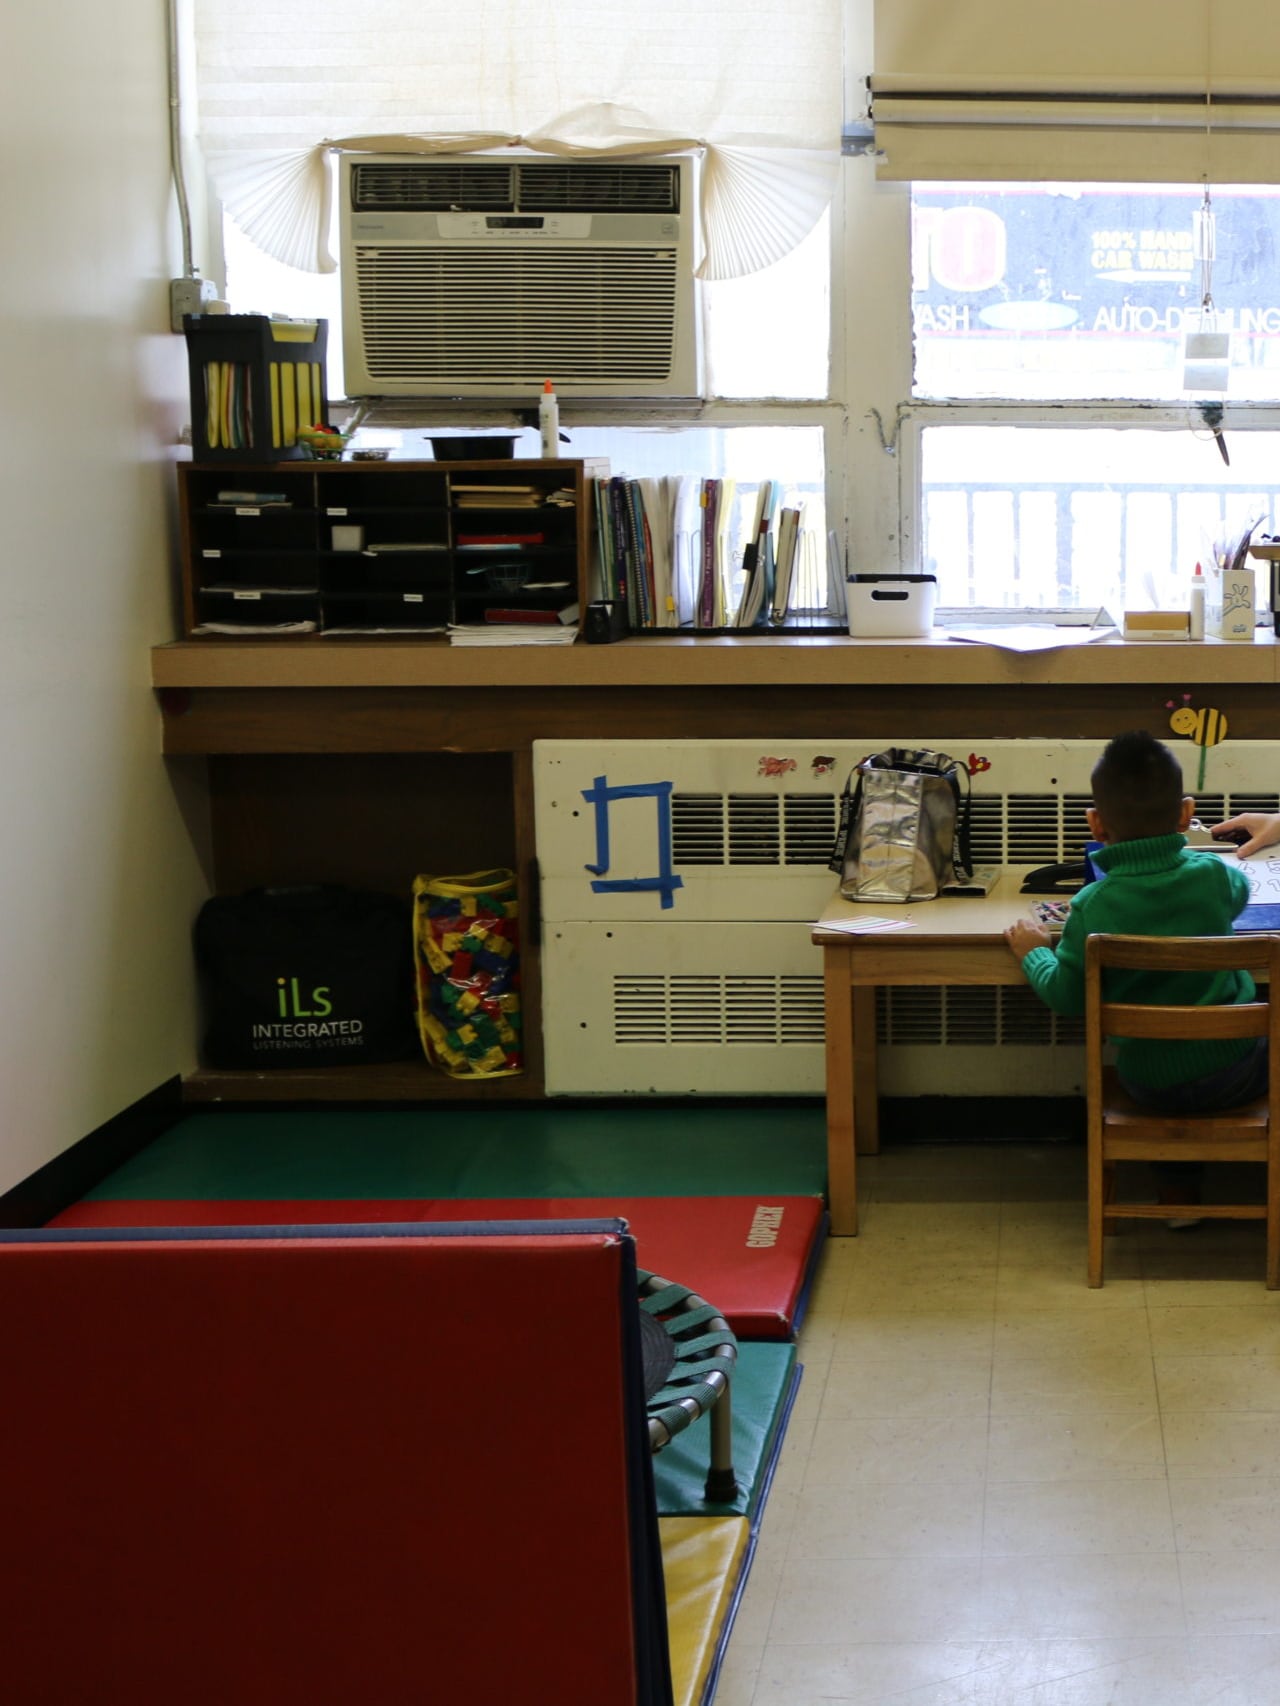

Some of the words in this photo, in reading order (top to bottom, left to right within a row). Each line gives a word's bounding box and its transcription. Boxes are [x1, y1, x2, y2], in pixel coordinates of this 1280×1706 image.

[1092, 230, 1136, 250] 100%
[1140, 230, 1193, 250] HAND
[1090, 250, 1134, 269] CAR
[1139, 250, 1195, 269] WASH
[252, 1019, 363, 1038] INTEGRATED
[252, 1037, 312, 1050] LISTENING
[315, 1035, 364, 1048] SYSTEMS
